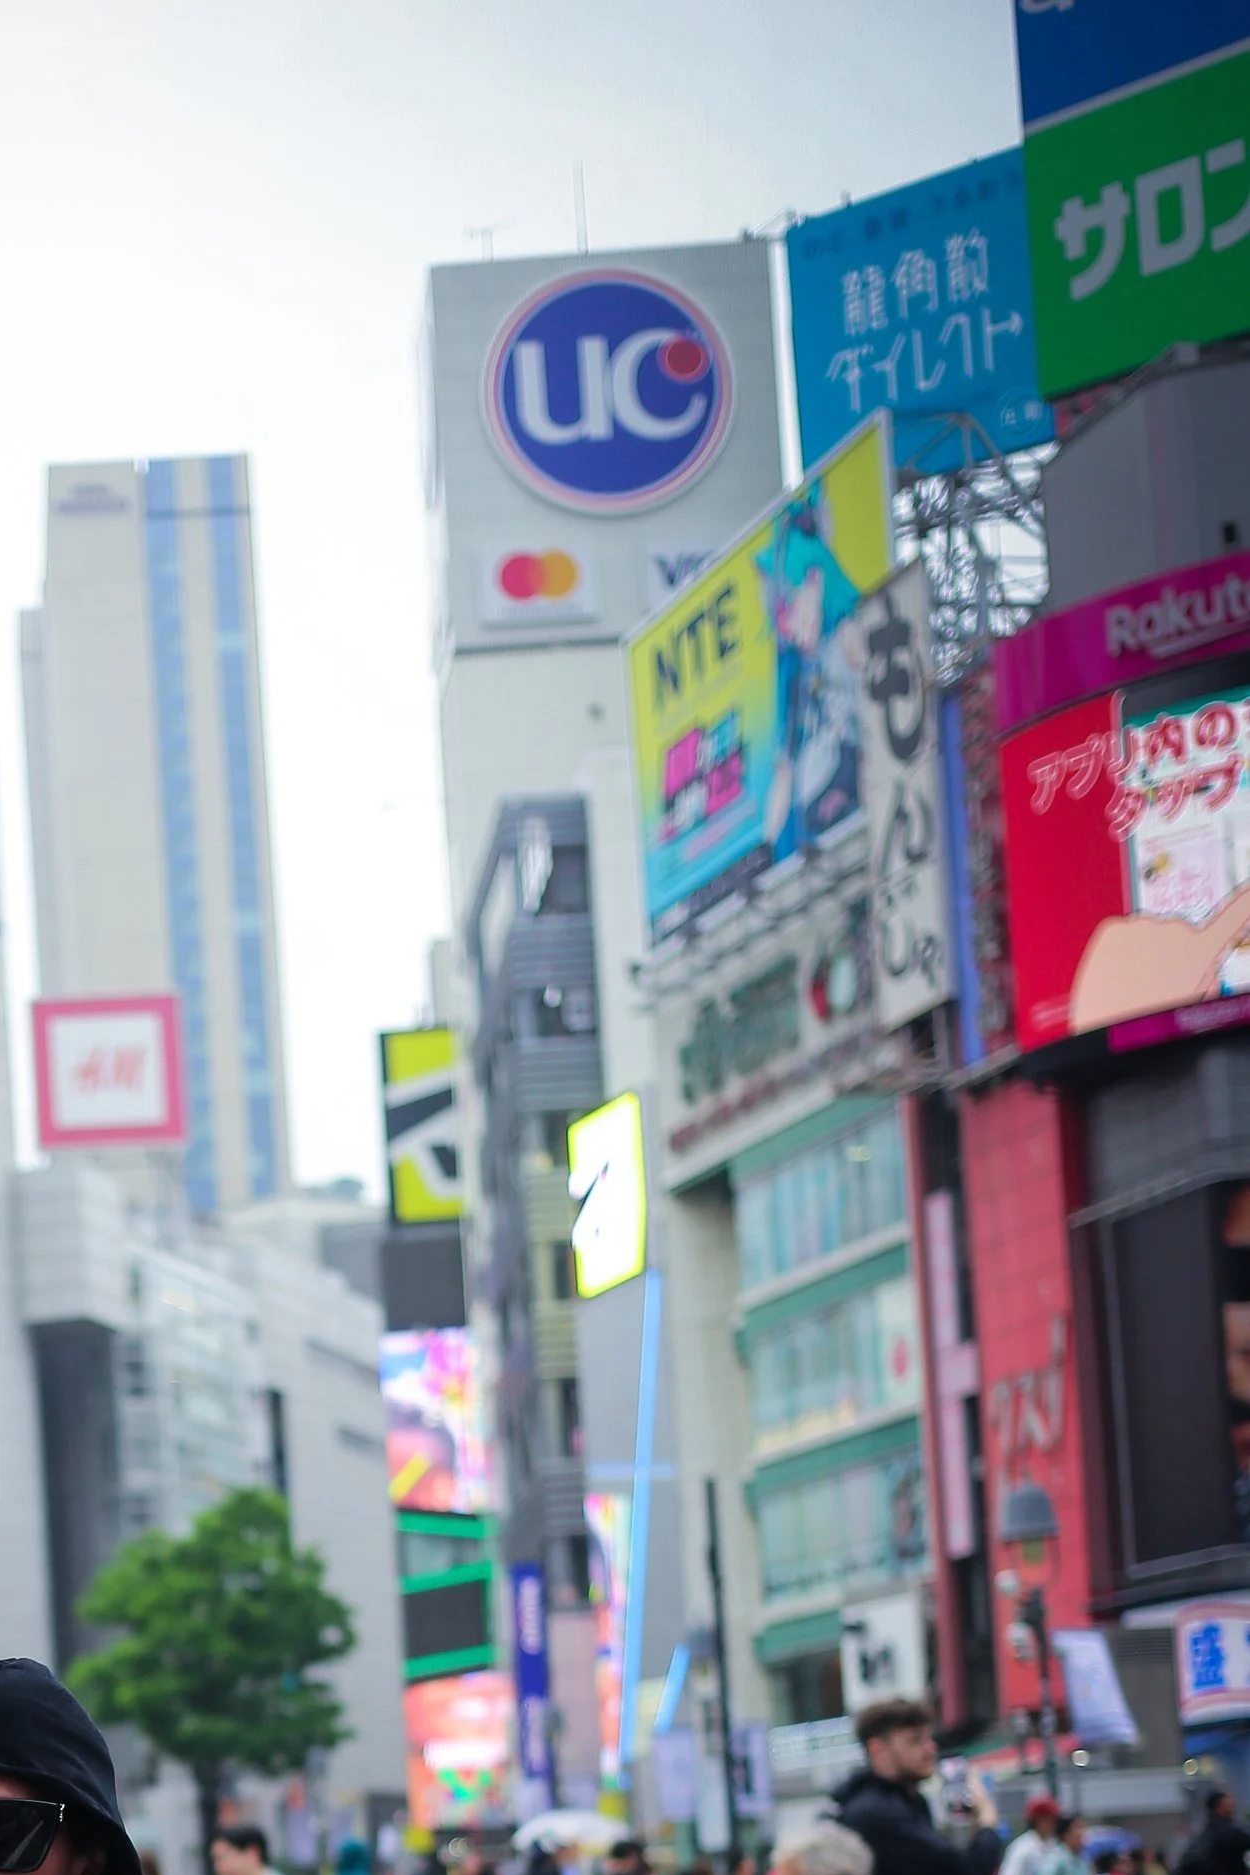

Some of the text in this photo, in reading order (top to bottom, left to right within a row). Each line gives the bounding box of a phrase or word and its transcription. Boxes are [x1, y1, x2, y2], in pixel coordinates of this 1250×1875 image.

[1054, 137, 1250, 301] サロン
[841, 226, 988, 338] 龍角散
[654, 578, 738, 712] NTE
[1105, 572, 1250, 660] Rakut
[1027, 688, 1250, 815] アプリ内の
[1105, 754, 1242, 842] タップ
